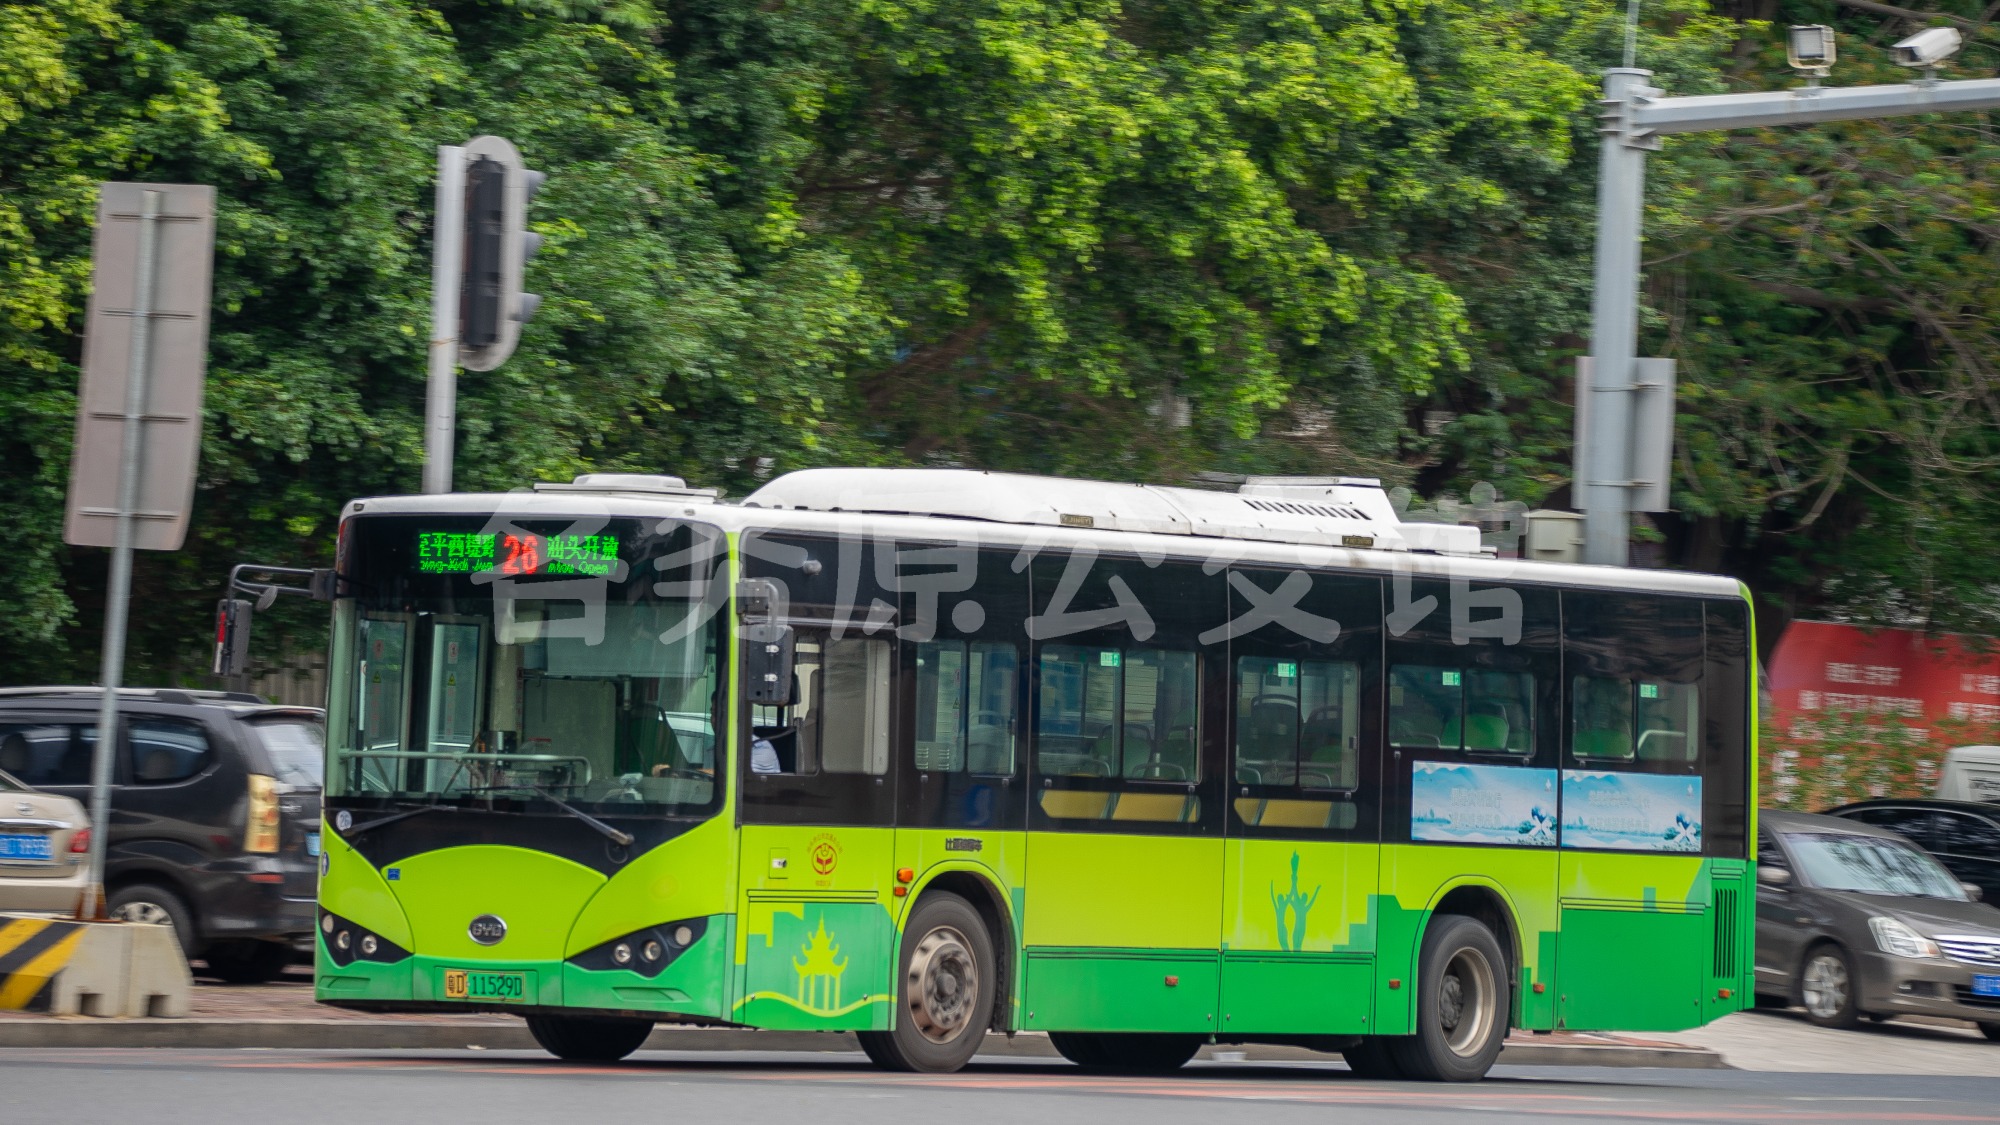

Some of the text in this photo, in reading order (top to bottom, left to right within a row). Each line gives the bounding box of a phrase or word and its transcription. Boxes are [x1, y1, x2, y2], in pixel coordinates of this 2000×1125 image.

[502, 534, 539, 575] 26
[471, 922, 502, 936] BYD
[472, 975, 523, 997] 11529D
